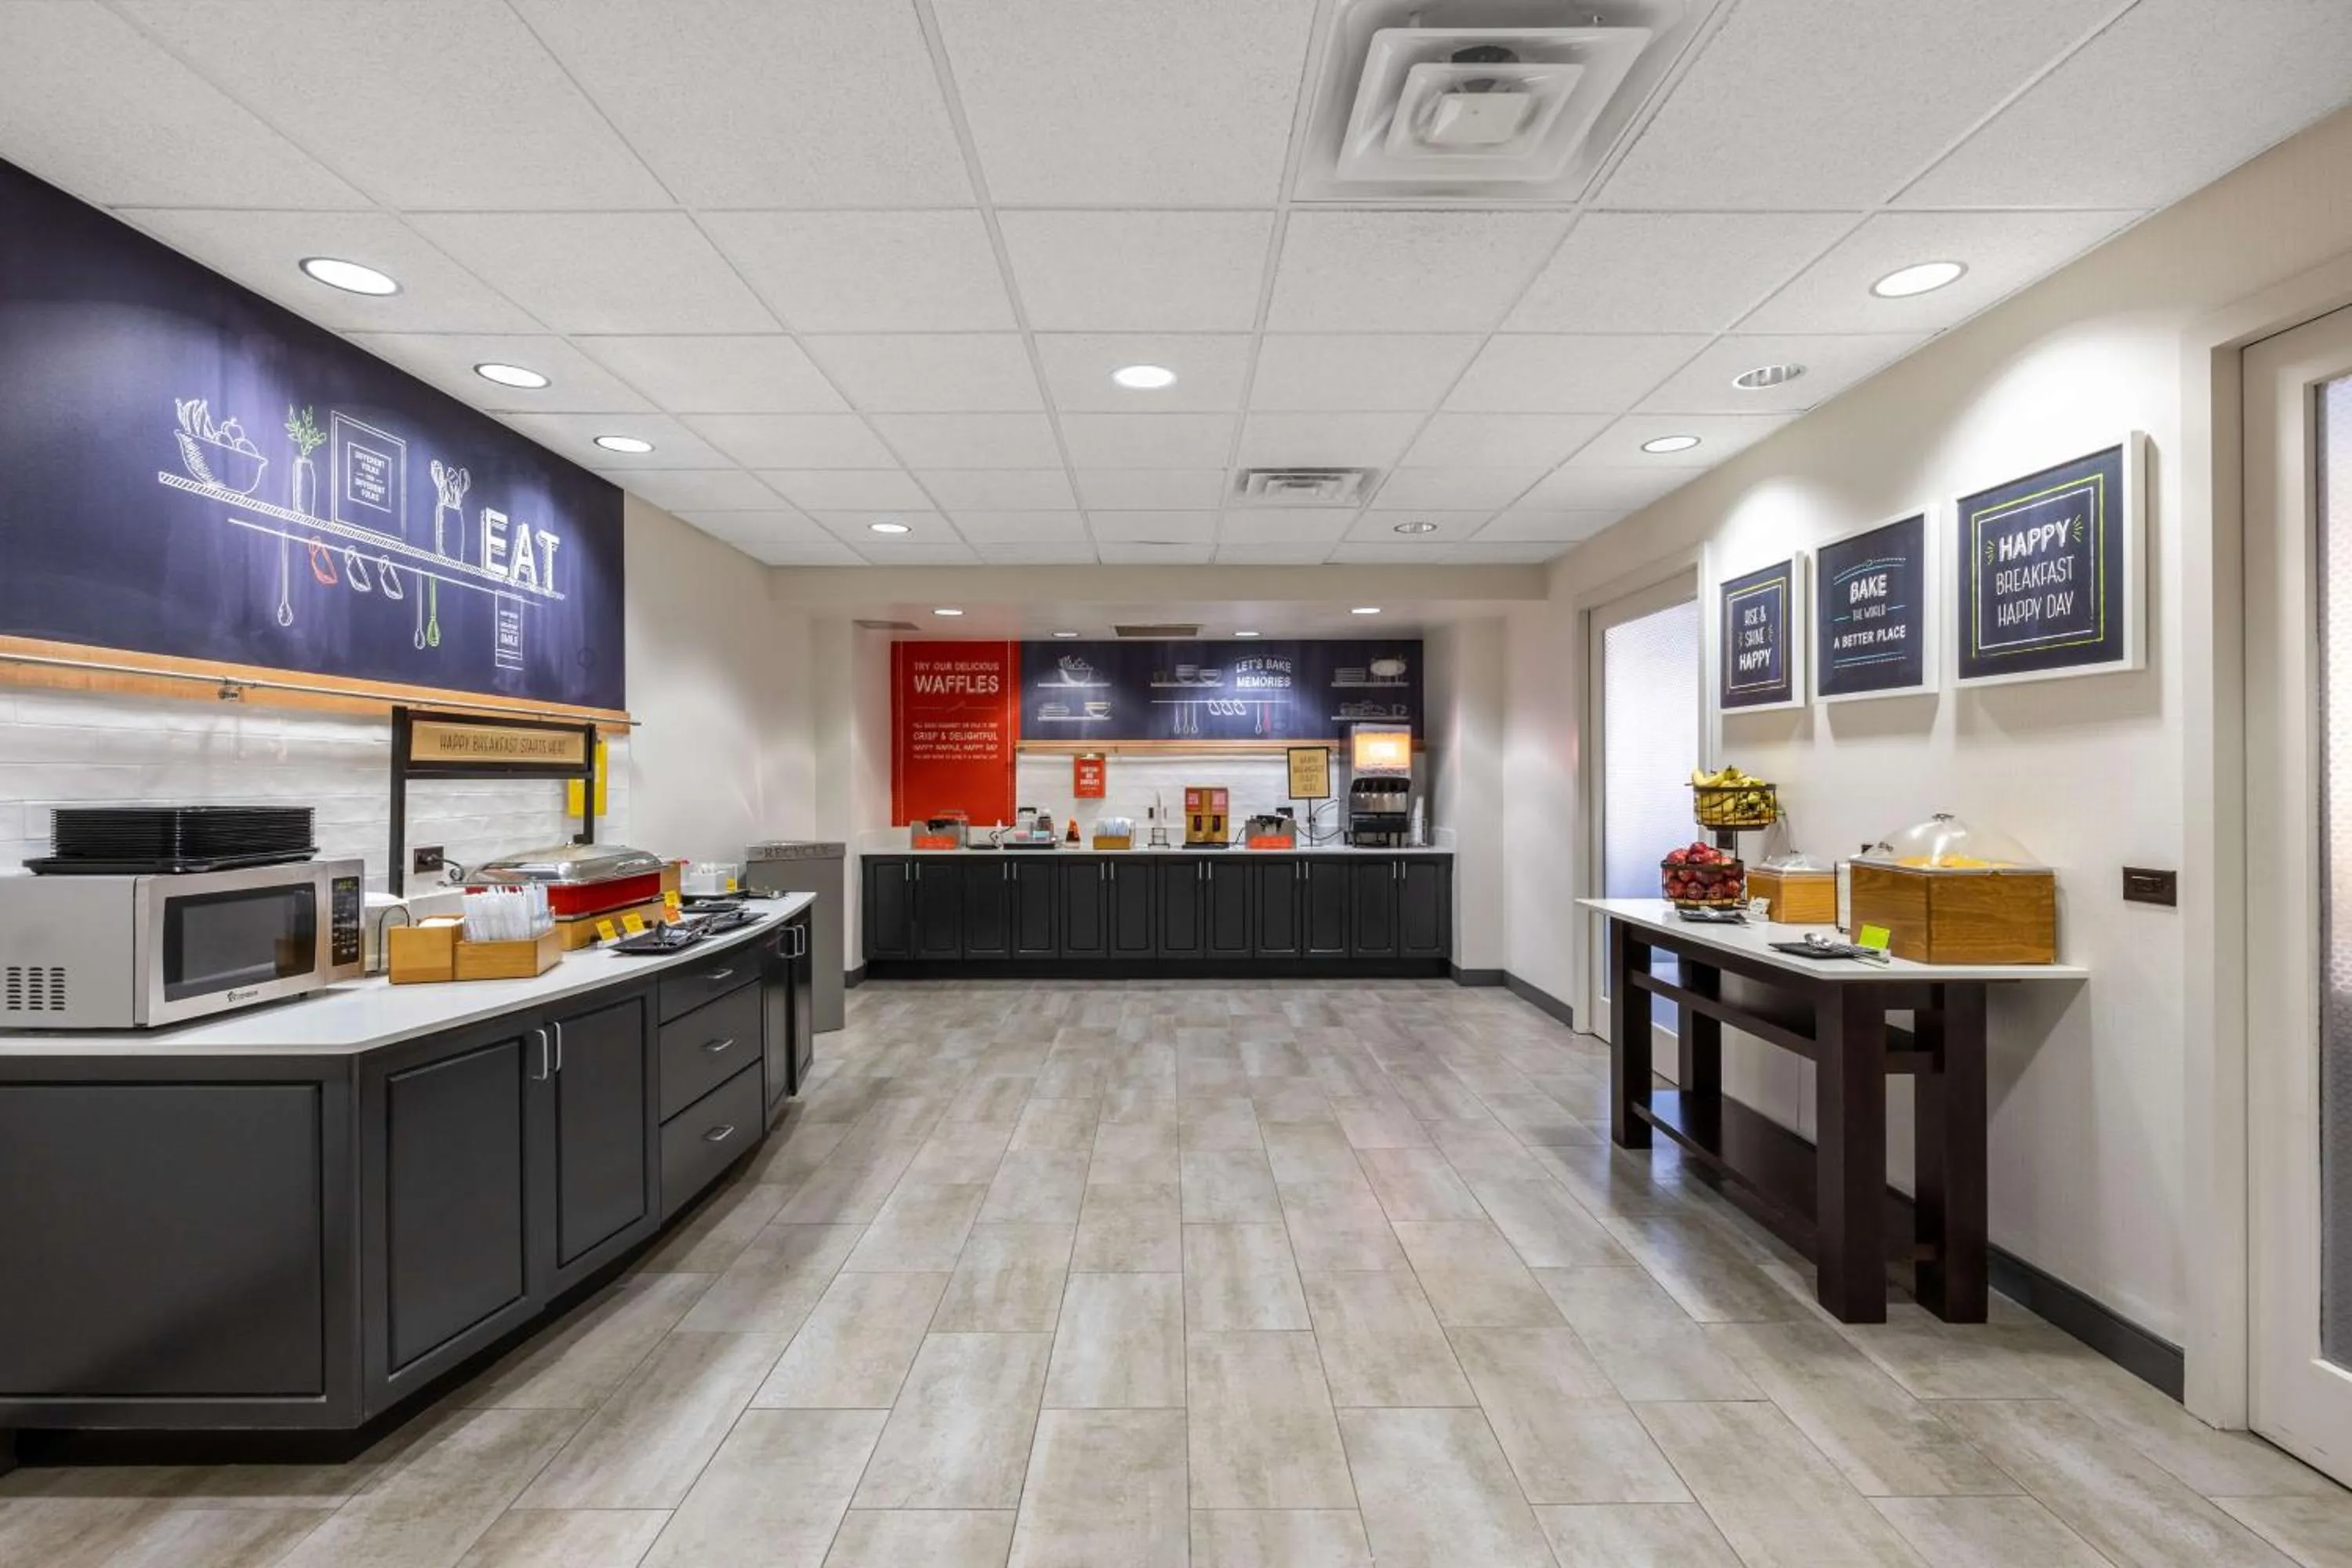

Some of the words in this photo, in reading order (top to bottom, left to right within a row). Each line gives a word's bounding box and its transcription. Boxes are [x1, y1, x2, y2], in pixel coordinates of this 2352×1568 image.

[481, 507, 560, 591] EAT
[1998, 517, 2071, 562] HAPPY
[1995, 554, 2074, 595] BREAKFAST
[1849, 573, 1887, 604] BAKE
[1864, 603, 1886, 619] WORLD
[1998, 596, 2042, 628] HAPPY
[2047, 590, 2074, 619] DAY
[1834, 637, 1840, 650] A
[1842, 630, 1875, 648] BETTER
[1876, 624, 1906, 642] PLACE
[914, 662, 929, 671] TRY
[934, 662, 952, 671] OUR
[954, 662, 1000, 671] DELICIOUS
[1236, 658, 1263, 673] LET'S
[1266, 659, 1291, 673] BAKE
[1739, 648, 1772, 672] HAPPY
[913, 674, 1000, 694] WAFFLES
[1236, 676, 1291, 688] MEMORIES
[440, 733, 470, 750] HAPPY
[473, 735, 518, 753] BREAKFAST
[521, 737, 546, 753] STARTS
[548, 739, 566, 755] HERE
[913, 731, 938, 741] CRISP
[949, 731, 998, 741] DELIGHTFUL
